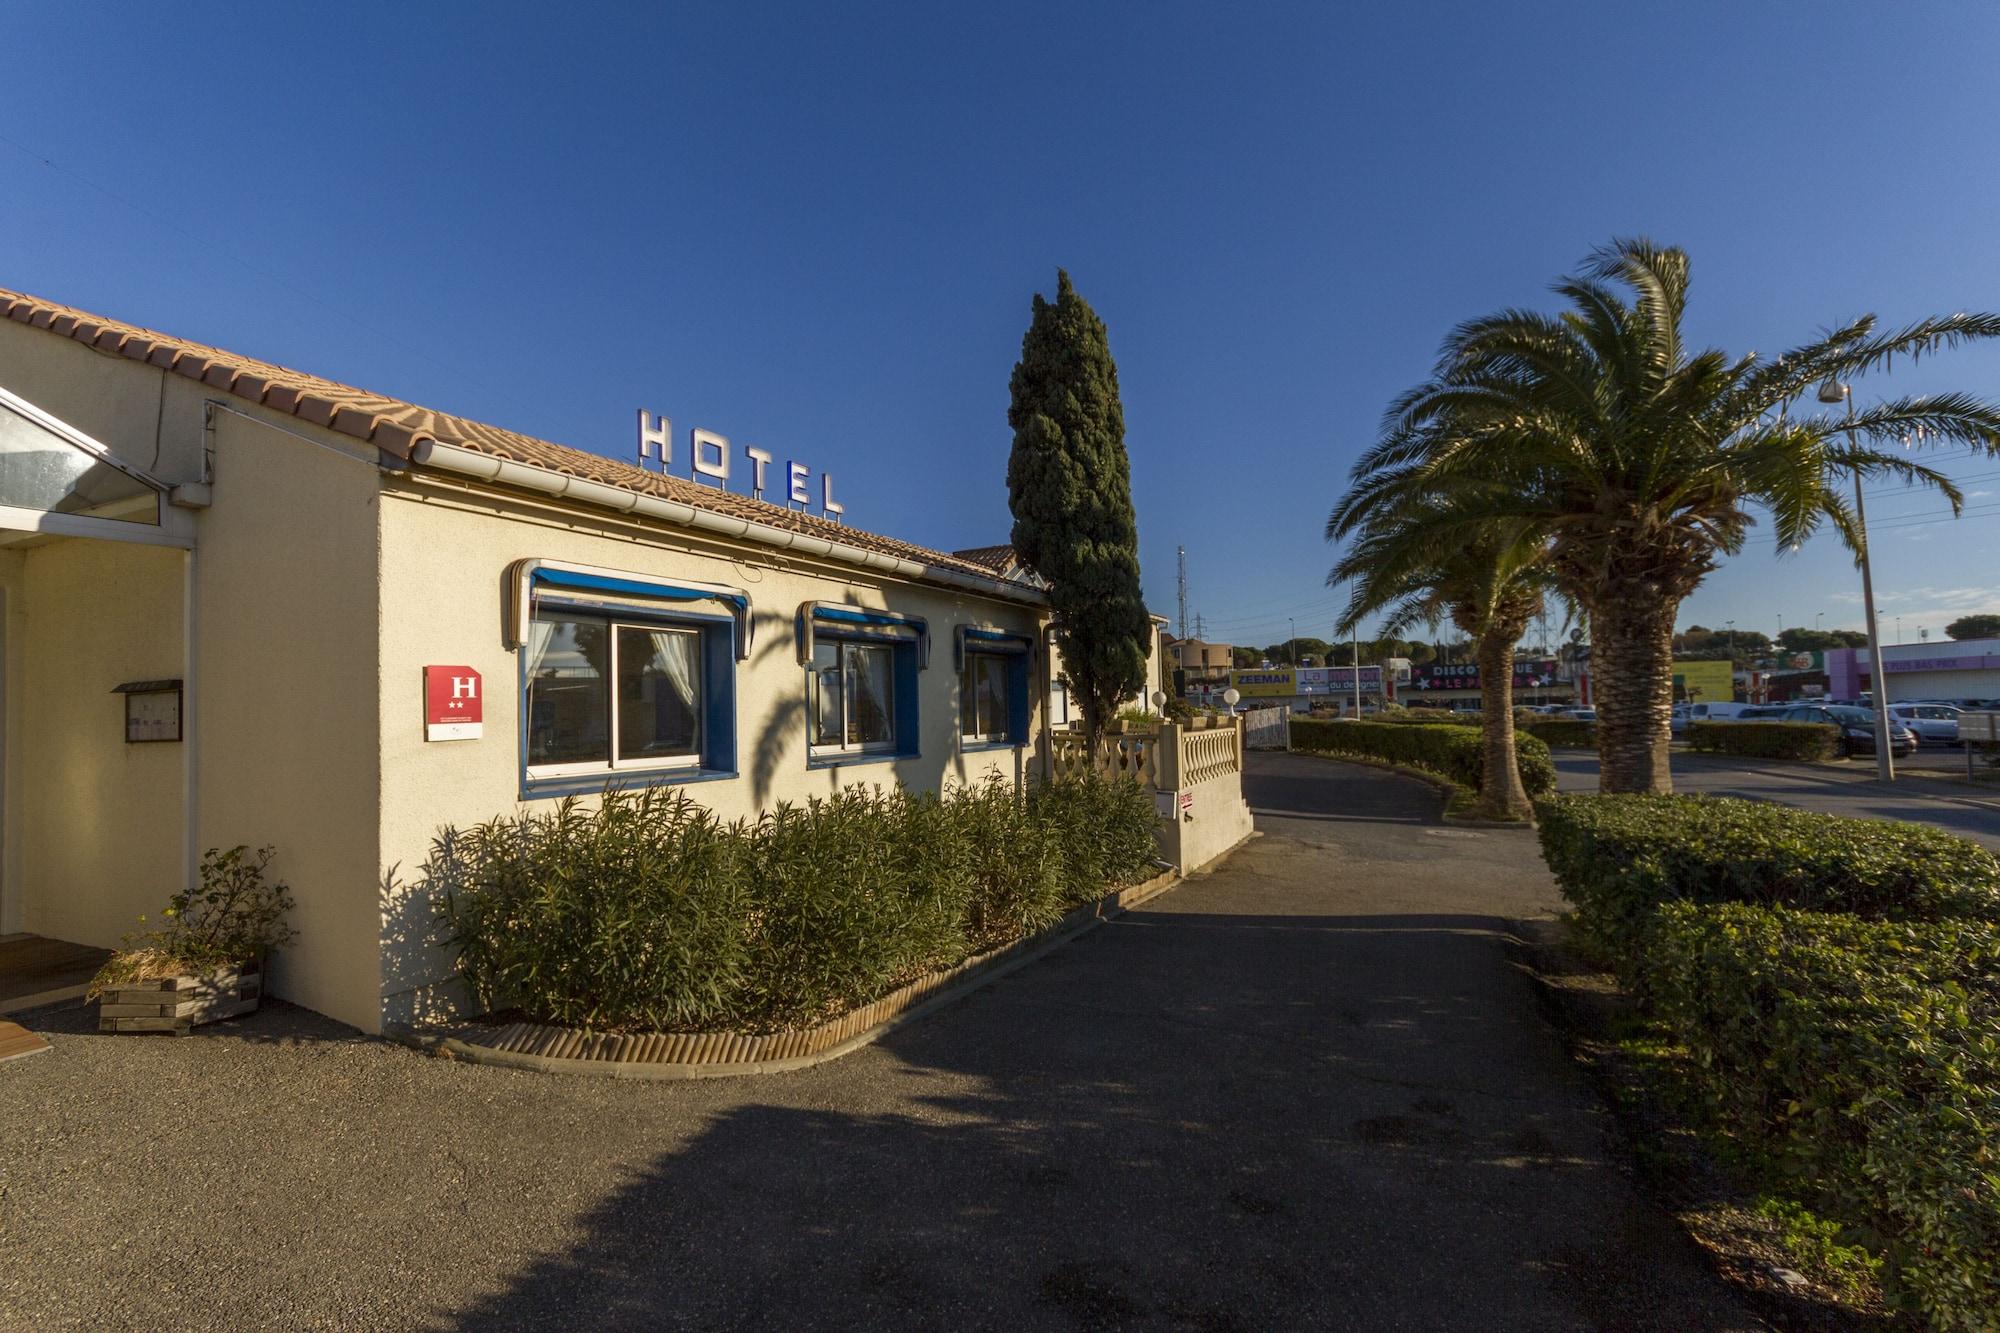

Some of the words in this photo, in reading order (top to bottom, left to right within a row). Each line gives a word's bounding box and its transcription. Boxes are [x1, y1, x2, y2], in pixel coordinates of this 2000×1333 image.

[637, 408, 844, 514] HOTEL
[1238, 674, 1290, 684] ZEEMAN
[1445, 678, 1462, 688] LE
[451, 677, 478, 698] H
[1329, 681, 1342, 689] du
